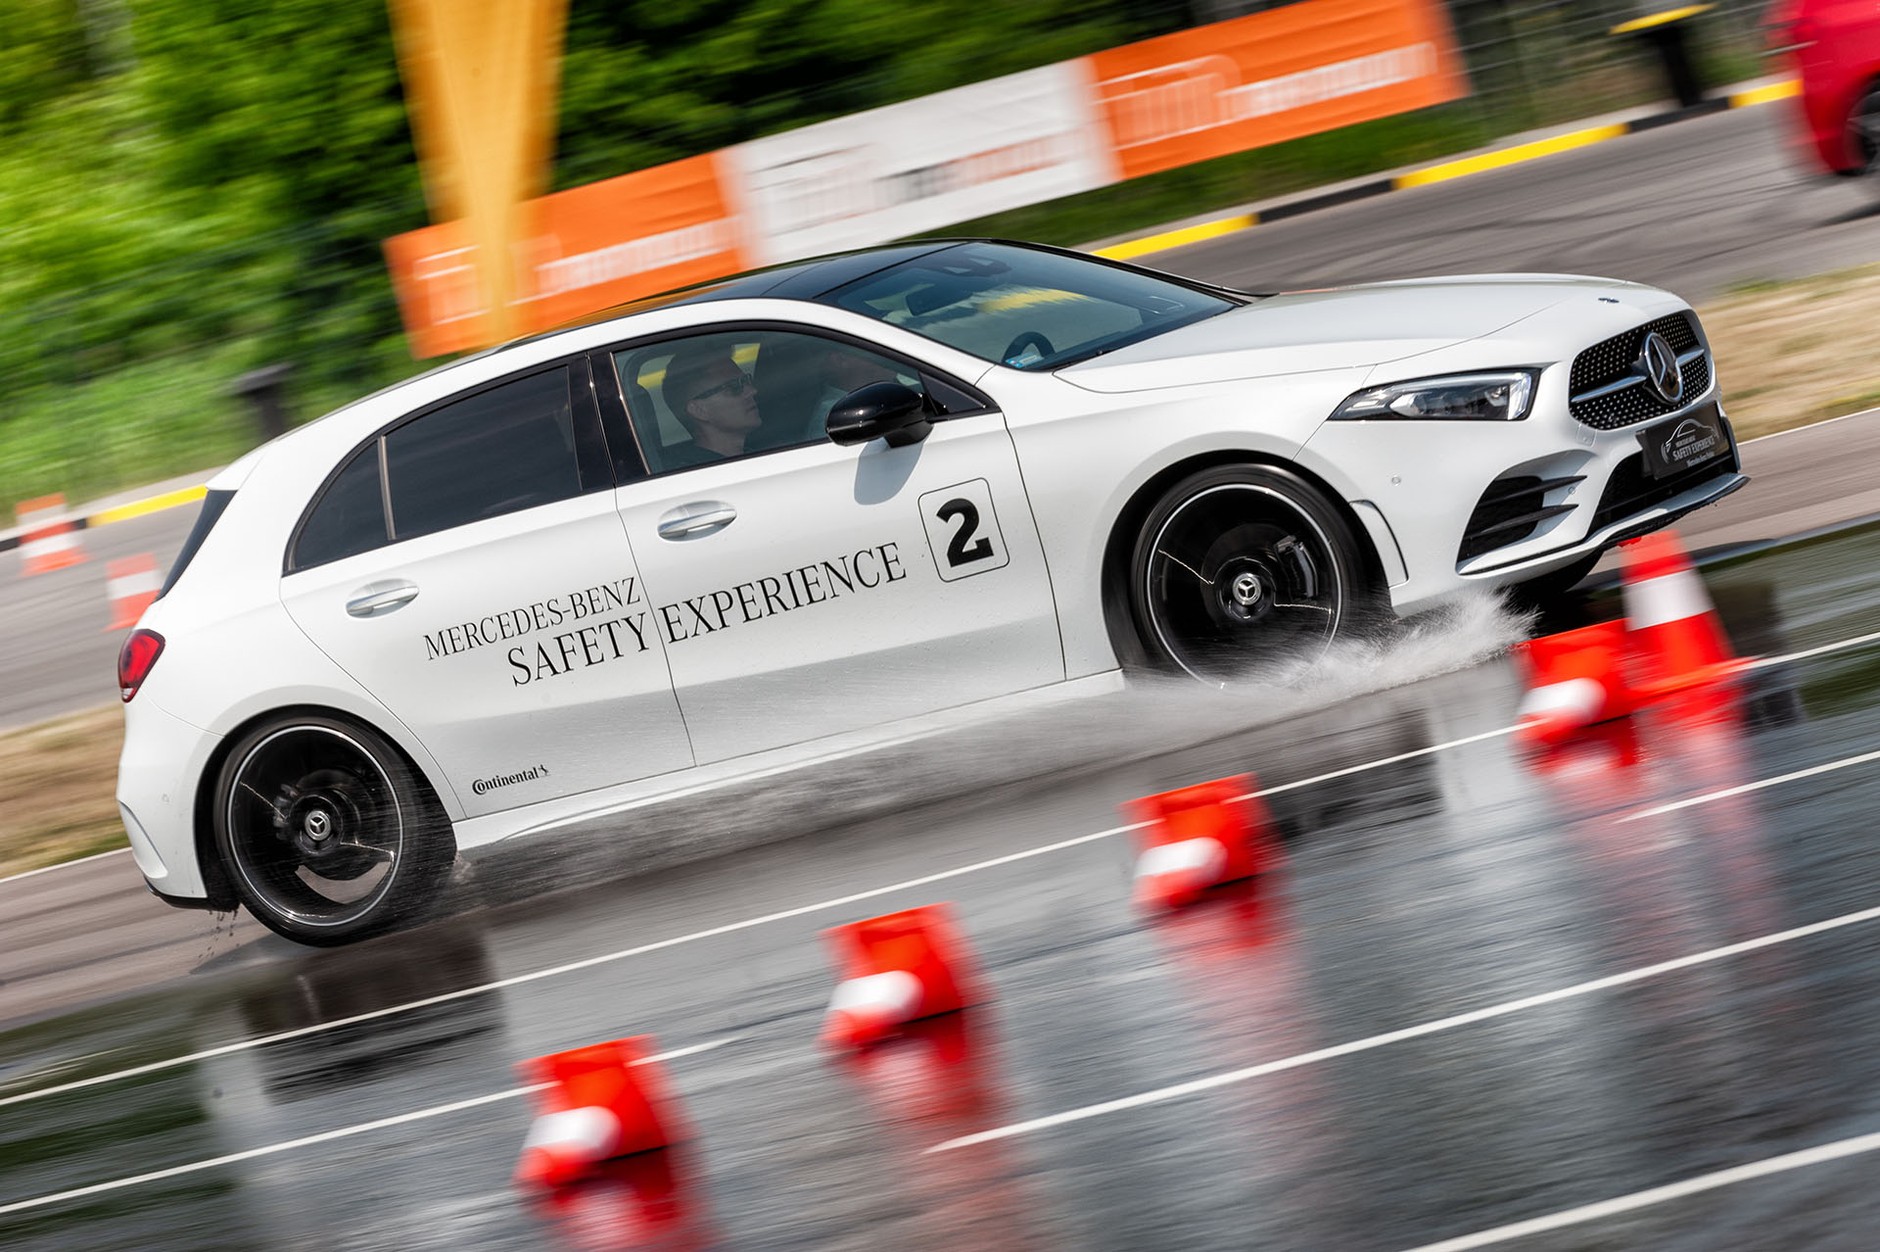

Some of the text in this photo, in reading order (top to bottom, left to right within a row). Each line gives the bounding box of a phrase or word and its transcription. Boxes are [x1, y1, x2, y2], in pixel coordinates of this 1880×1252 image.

[936, 498, 995, 568] 2
[424, 577, 641, 660] MERCEDES-BENZ
[507, 542, 907, 687] SAFETY EXPERIENCE
[471, 766, 540, 796] Continental
